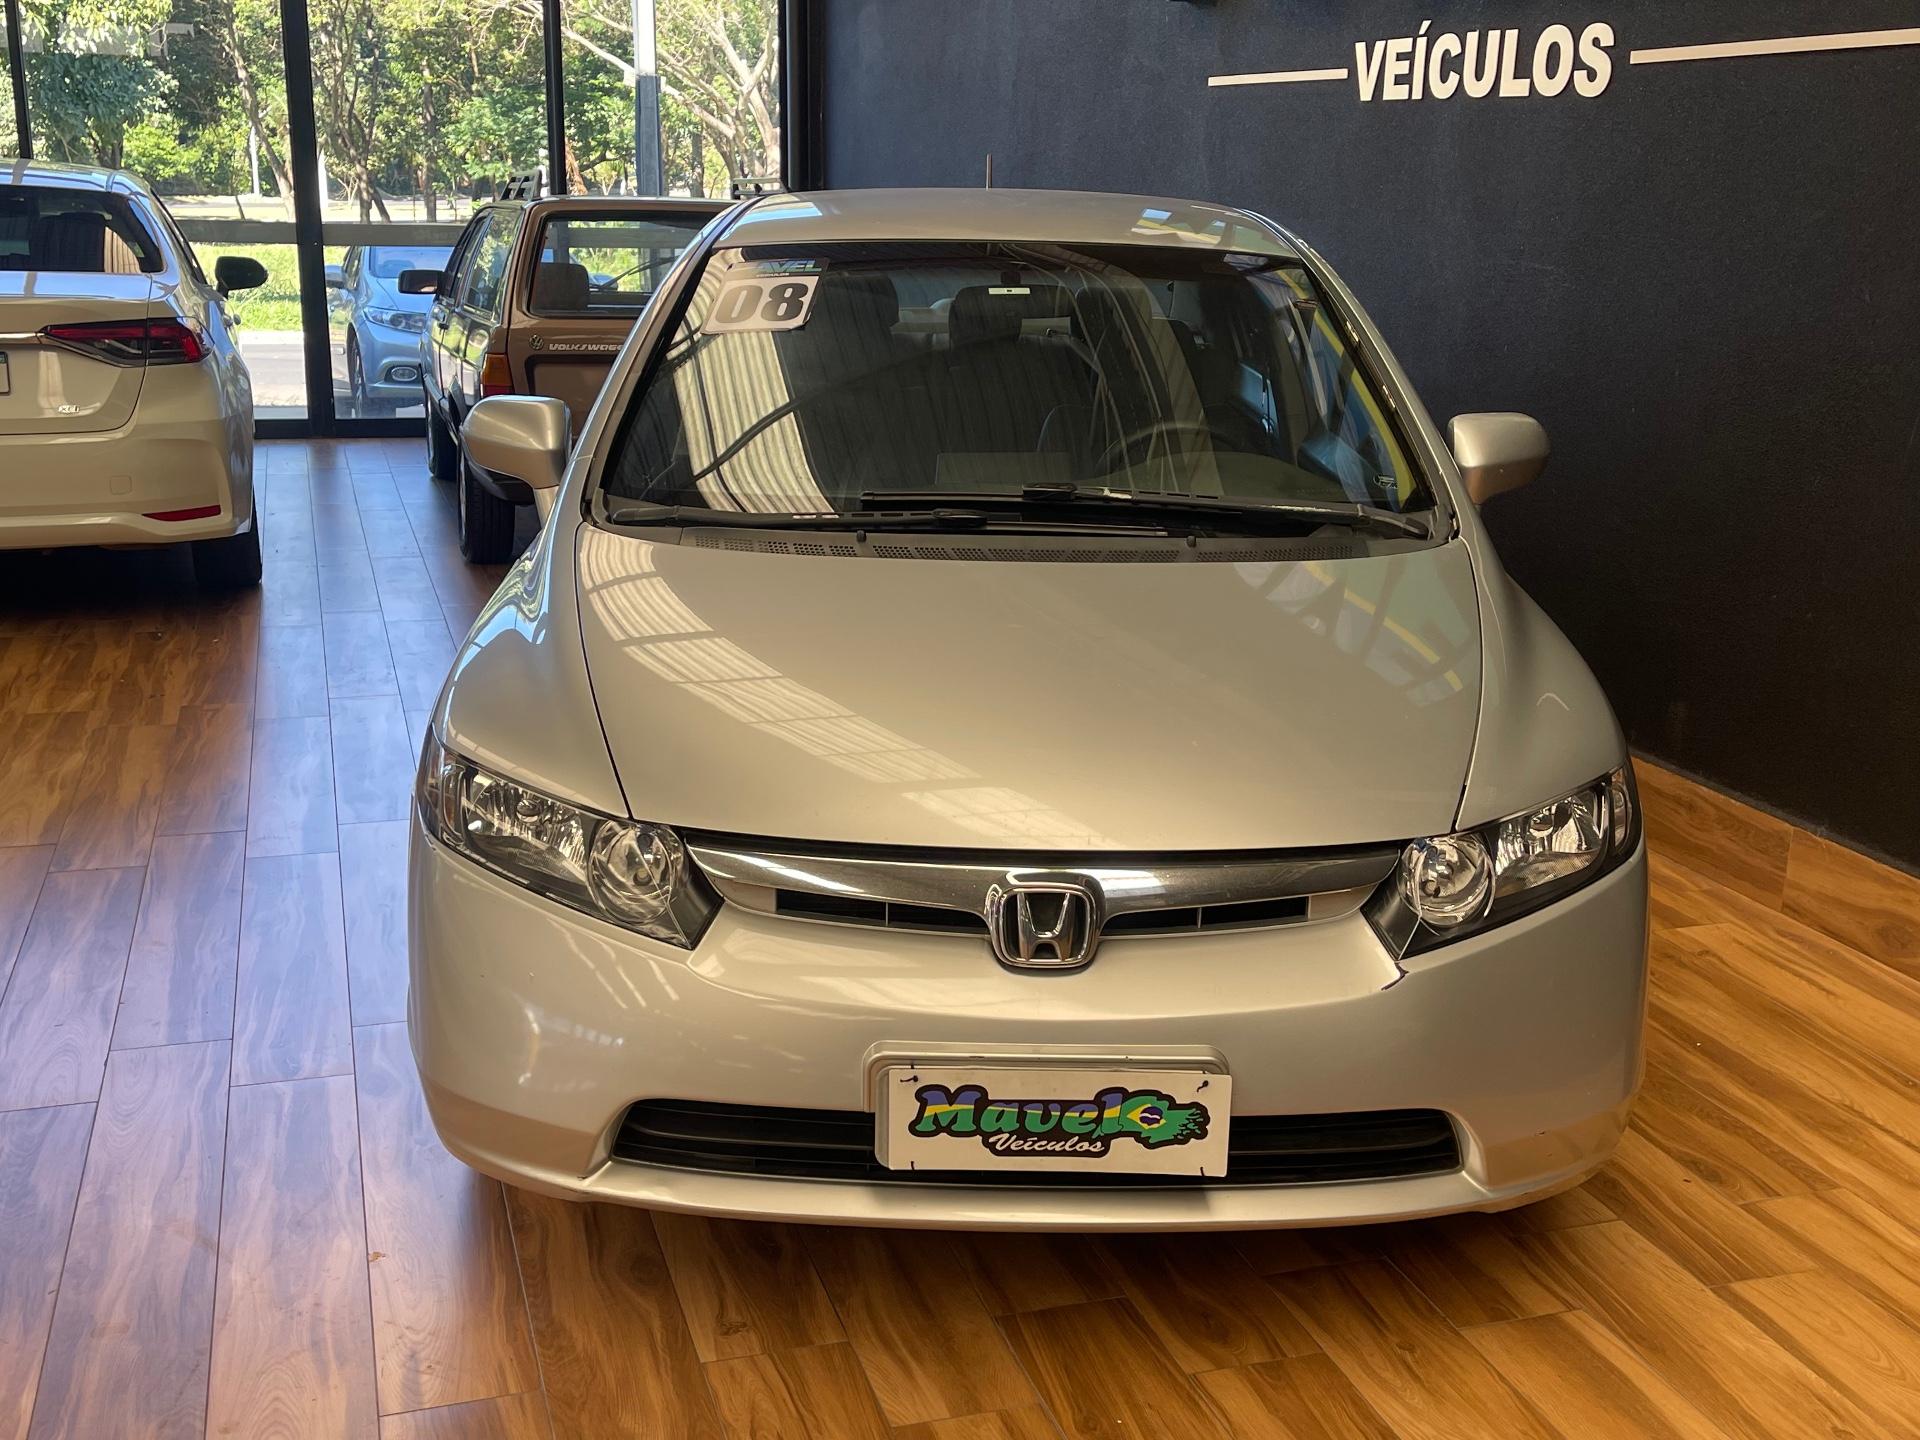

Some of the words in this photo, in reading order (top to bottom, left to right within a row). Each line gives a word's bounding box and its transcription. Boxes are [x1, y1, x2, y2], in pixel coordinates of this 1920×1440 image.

[1355, 20, 1615, 101] VEÍCULOS
[715, 282, 809, 323] 08
[549, 343, 624, 351] VOLKSWAG
[914, 1089, 1124, 1138] Mavel
[988, 1133, 1105, 1152] Veículos
